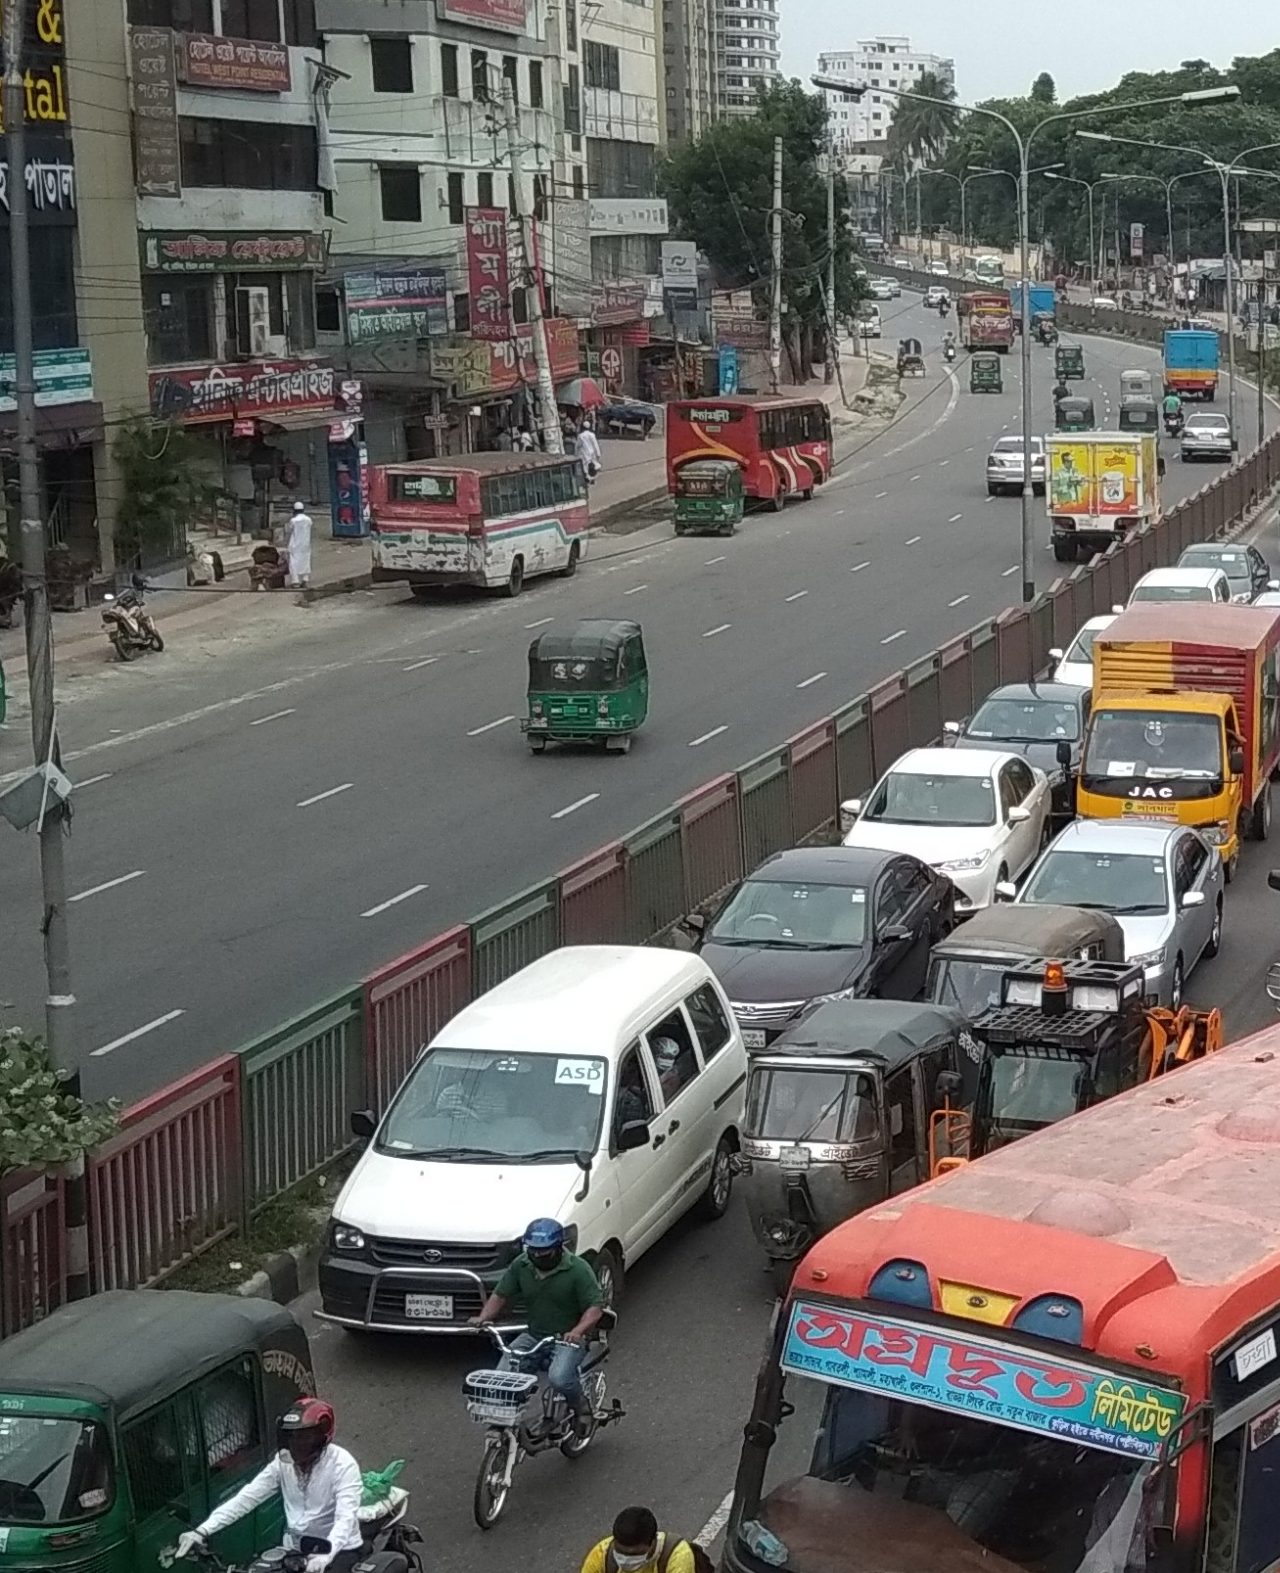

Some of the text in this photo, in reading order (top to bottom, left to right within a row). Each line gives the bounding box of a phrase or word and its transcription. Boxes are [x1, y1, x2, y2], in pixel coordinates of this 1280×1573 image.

[1128, 786, 1173, 798] JAC
[559, 1067, 601, 1080] ASD
[796, 1306, 1094, 1409] অগ্রদূত
[1091, 1379, 1177, 1437] লিমিটেড
